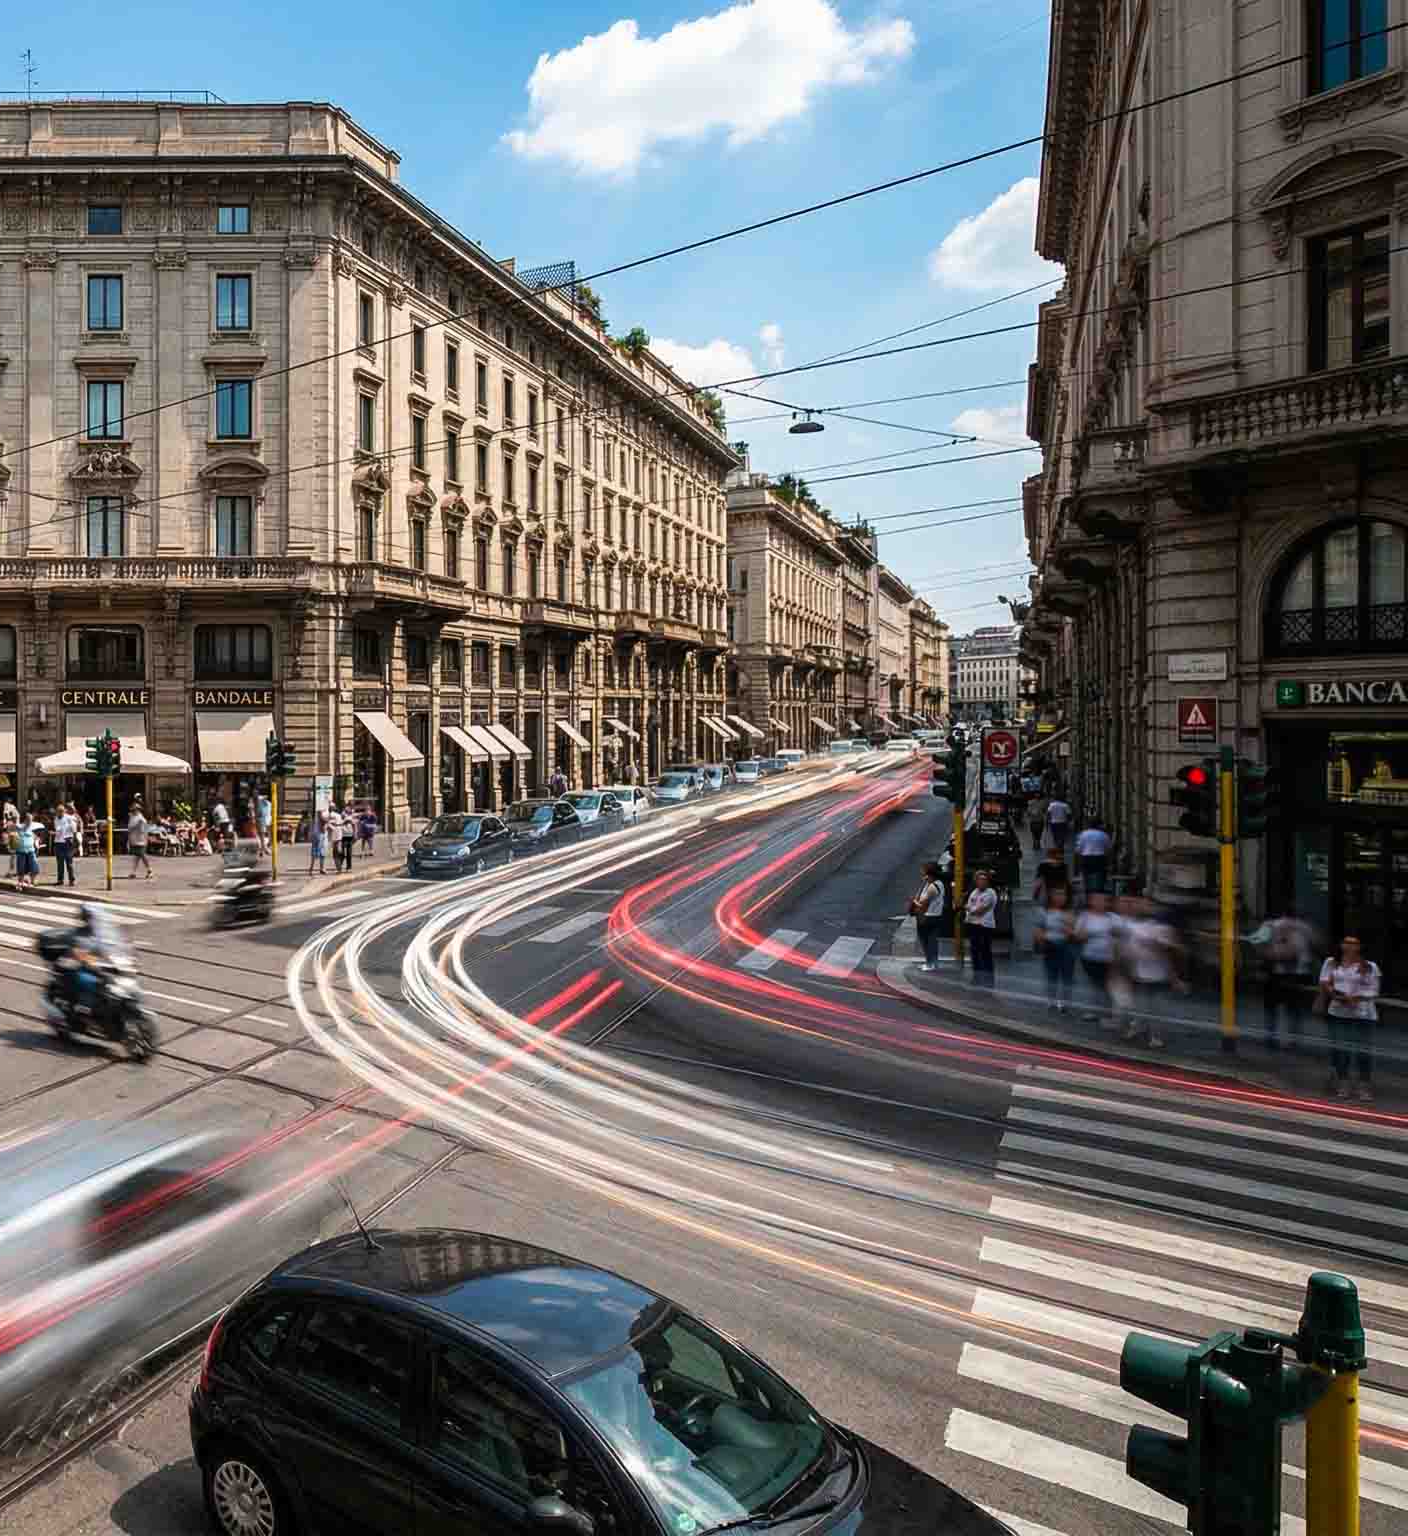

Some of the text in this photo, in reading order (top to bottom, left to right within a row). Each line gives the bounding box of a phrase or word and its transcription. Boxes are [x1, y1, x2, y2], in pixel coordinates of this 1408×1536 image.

[62, 691, 149, 704] CENTRALE
[195, 691, 273, 704] BANDALE
[1308, 681, 1408, 703] BANCA
